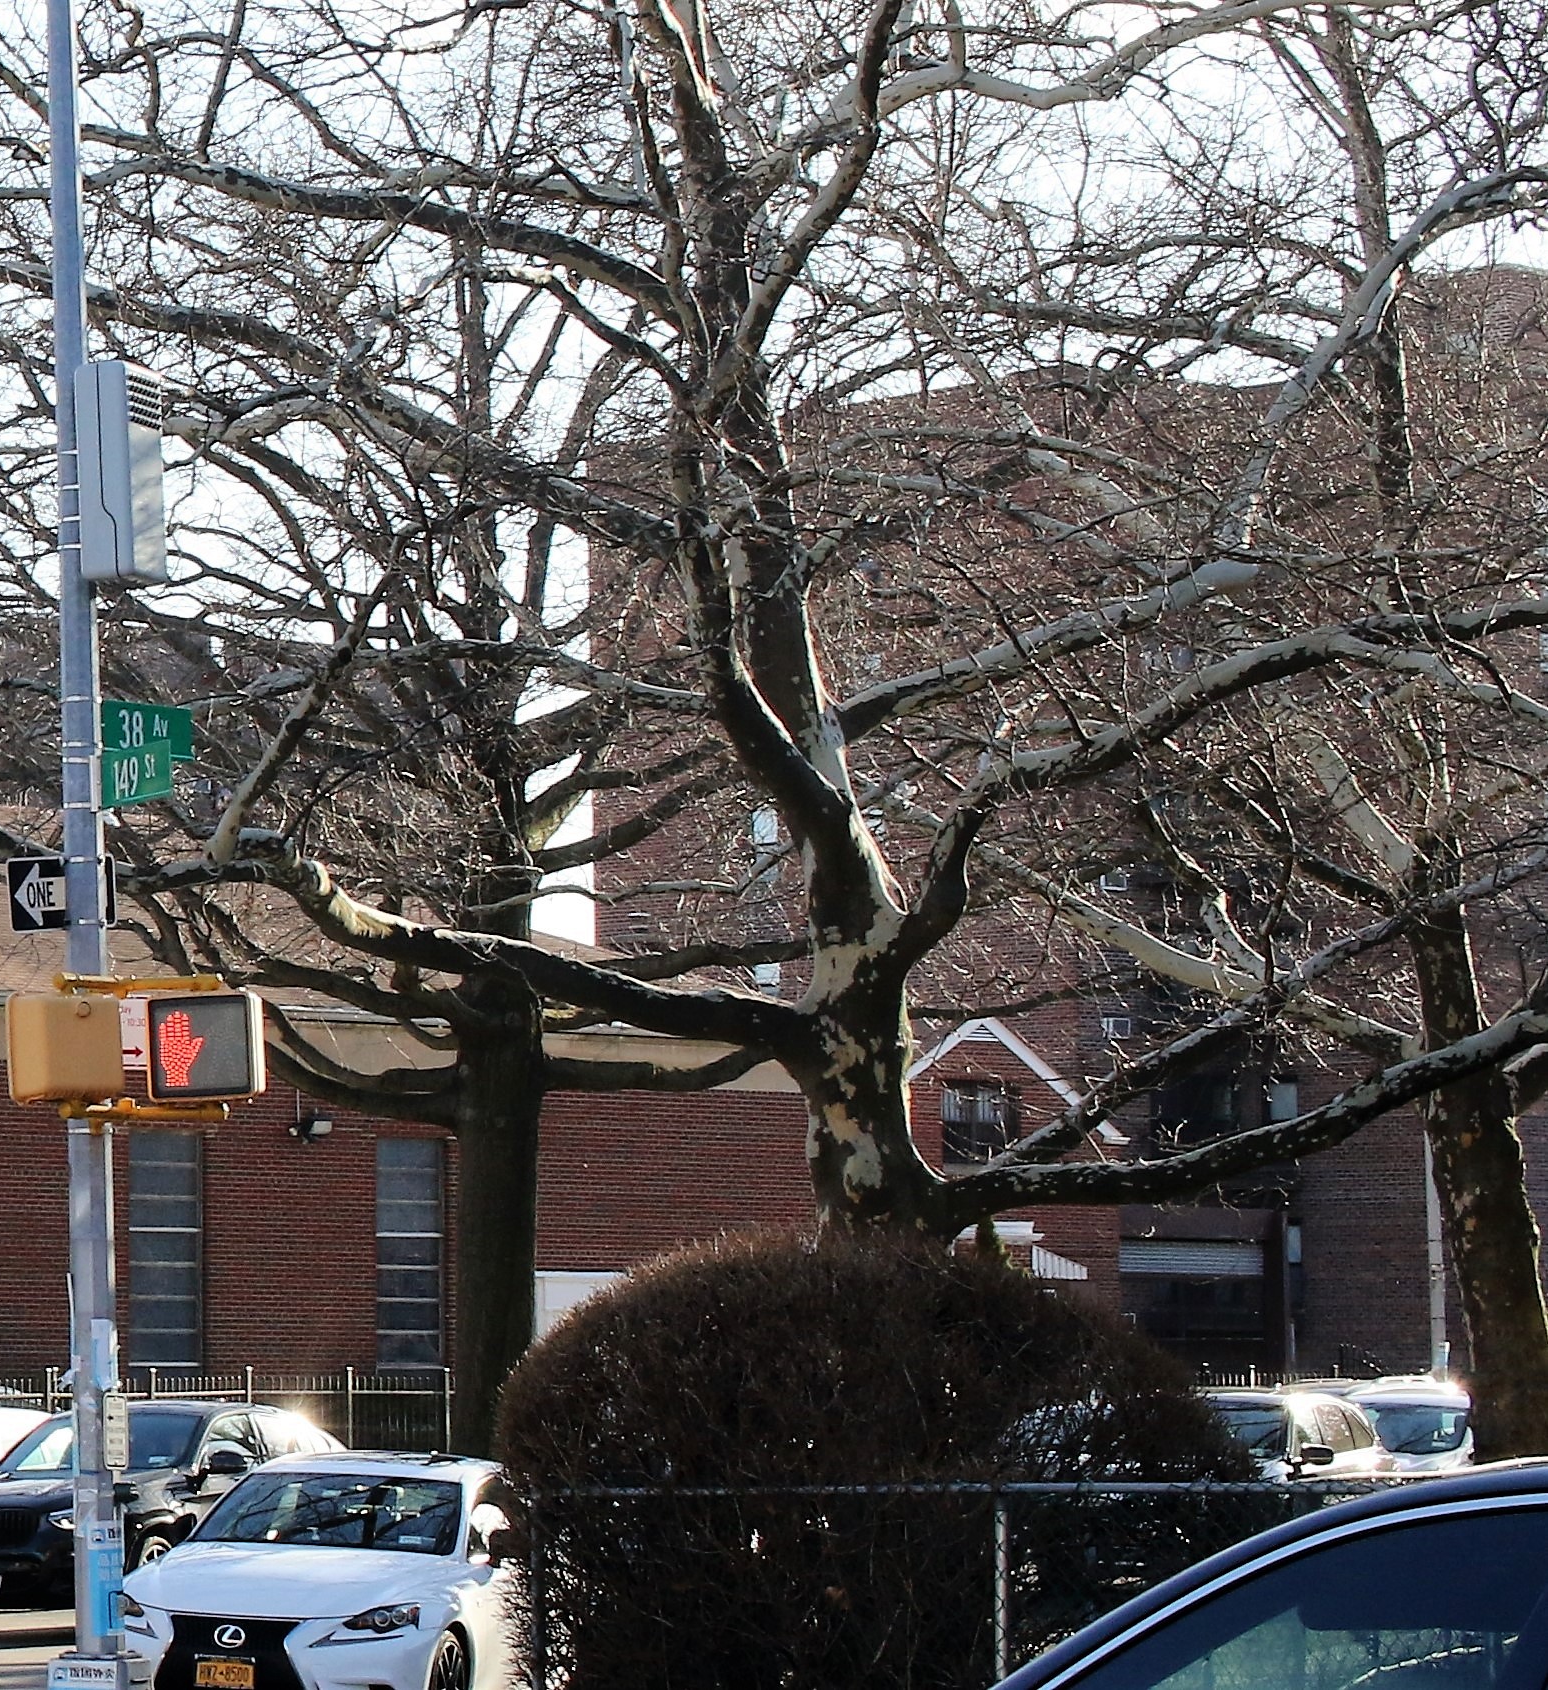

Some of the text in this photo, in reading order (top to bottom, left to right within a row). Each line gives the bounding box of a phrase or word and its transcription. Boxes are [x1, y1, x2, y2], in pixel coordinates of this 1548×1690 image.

[118, 709, 169, 748] 38 Av
[113, 753, 156, 800] 149 St
[26, 881, 55, 908] ONE
